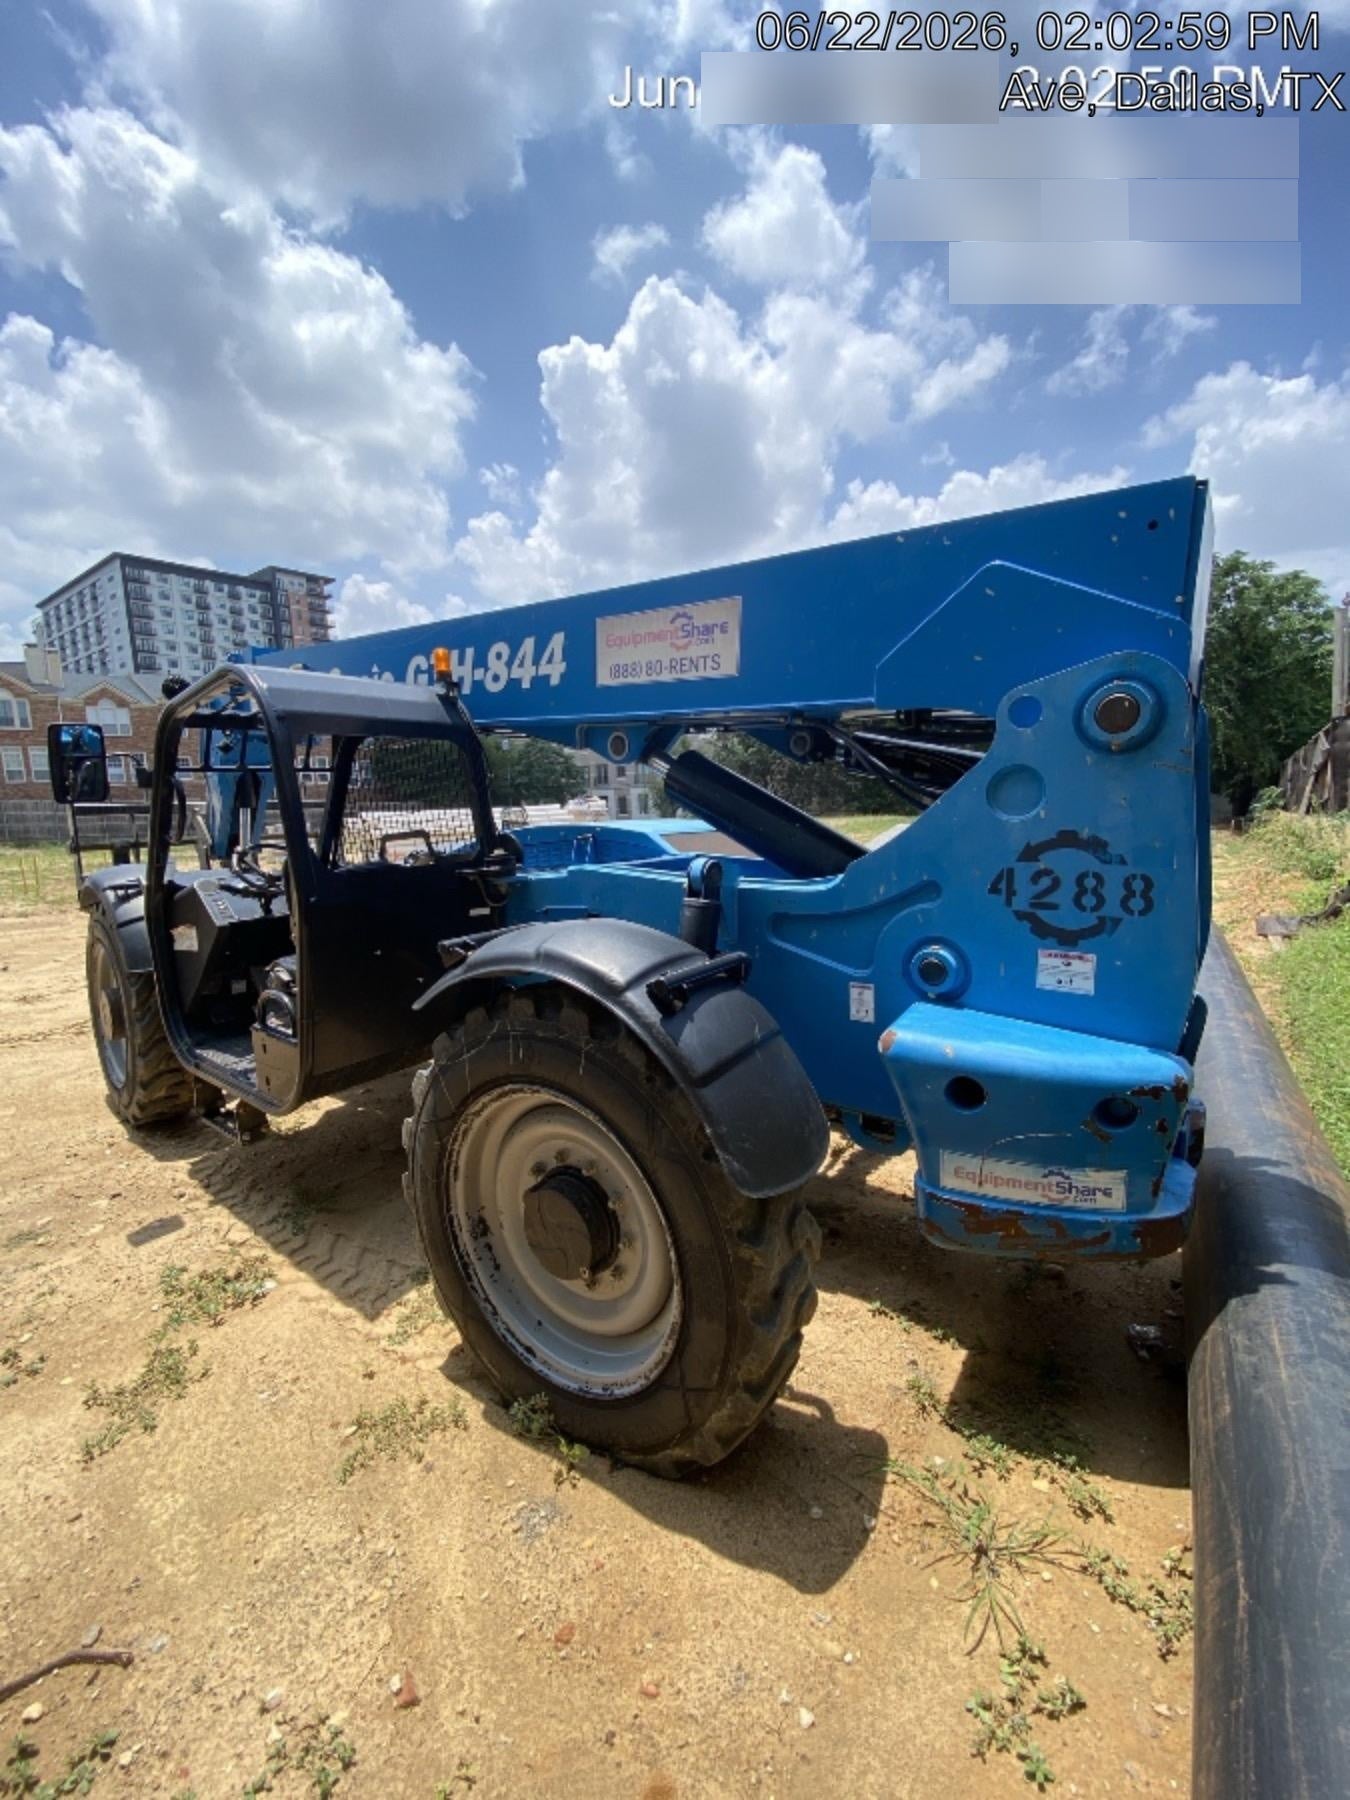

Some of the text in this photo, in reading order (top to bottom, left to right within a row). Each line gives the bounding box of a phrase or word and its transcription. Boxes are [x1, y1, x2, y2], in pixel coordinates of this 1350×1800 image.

[405, 631, 567, 695] GH-844
[609, 653, 721, 680] (888) 80-RENTS
[988, 867, 1155, 917] 4288
